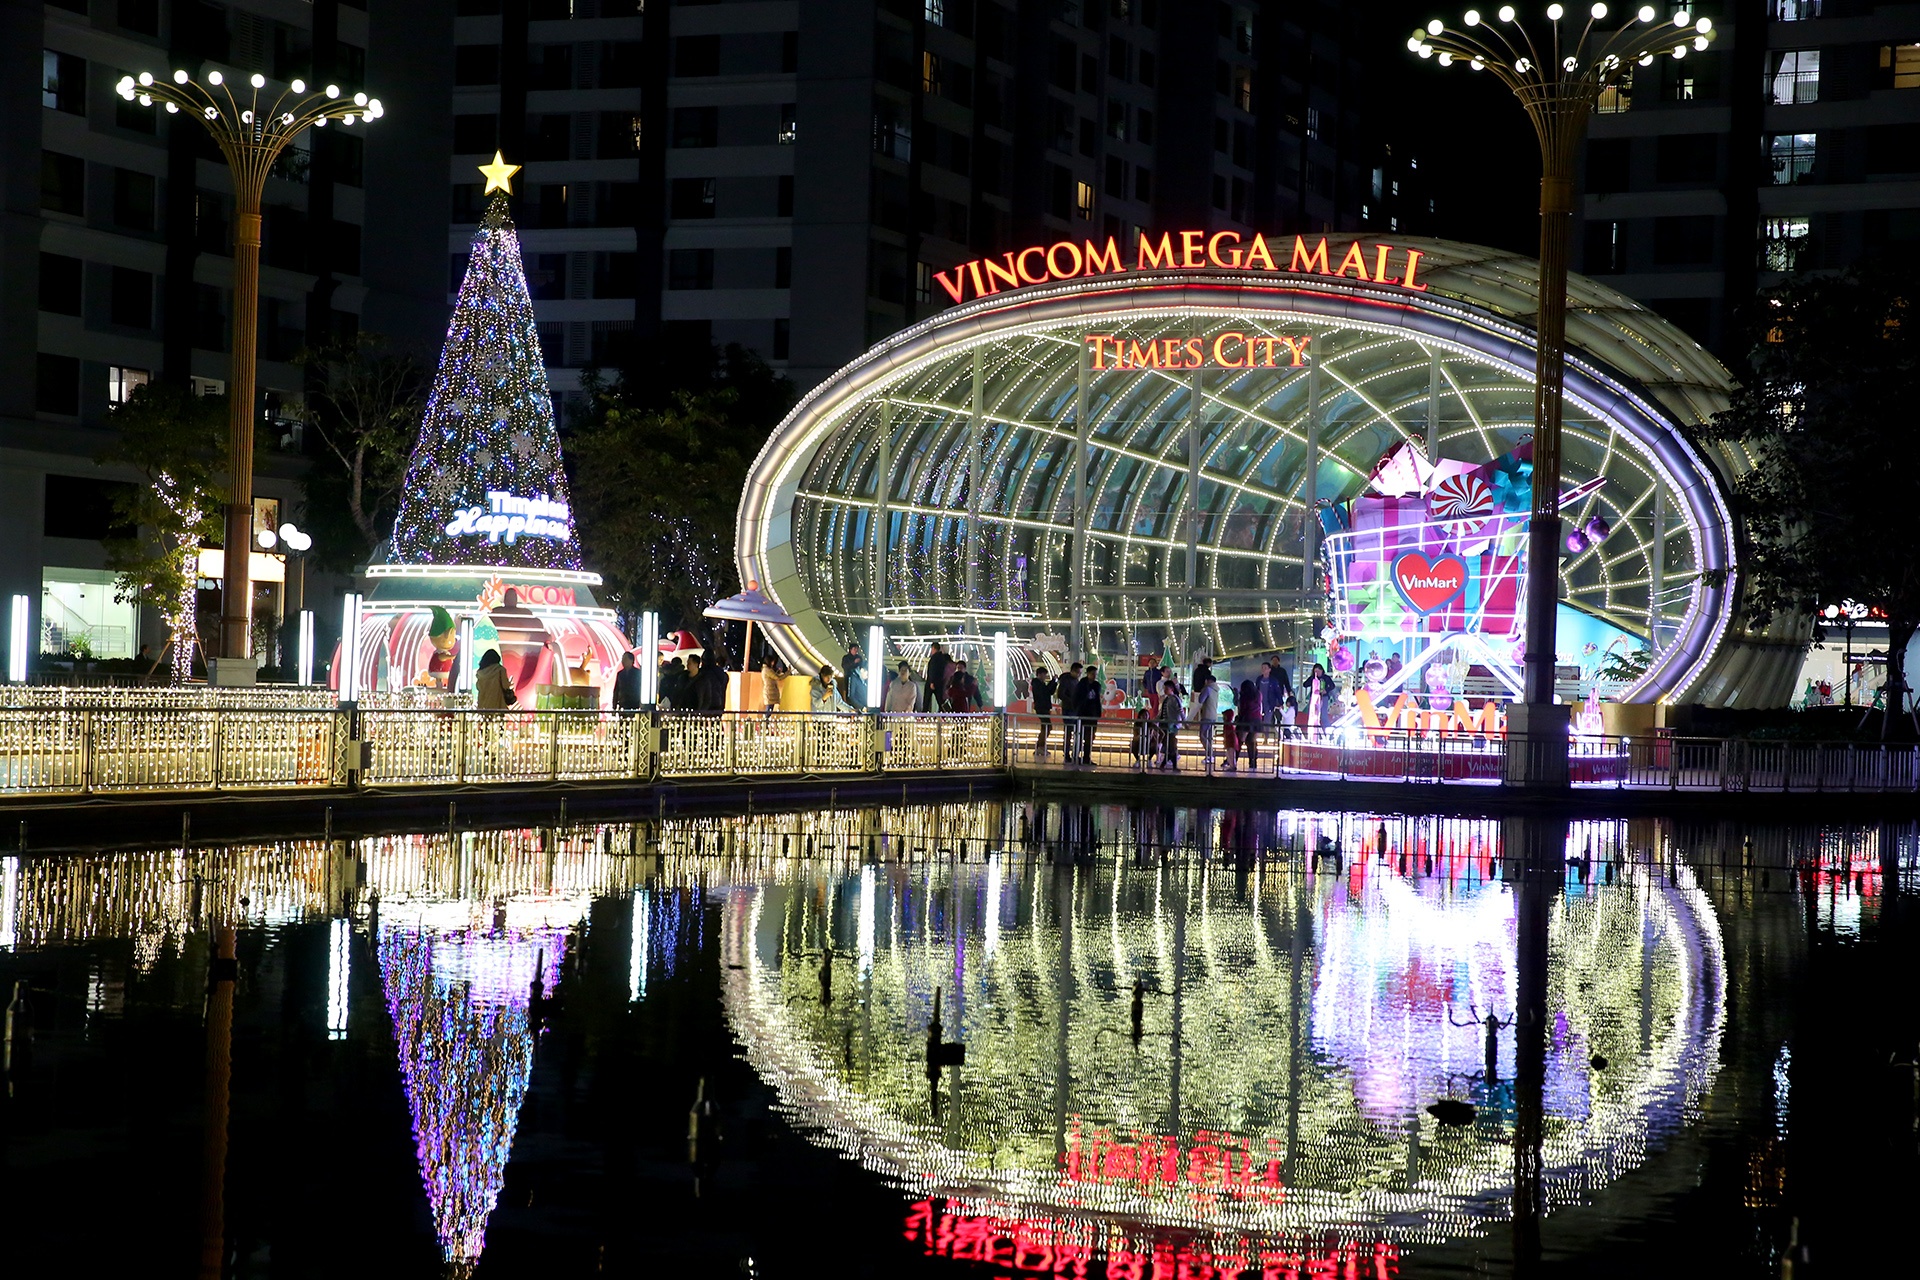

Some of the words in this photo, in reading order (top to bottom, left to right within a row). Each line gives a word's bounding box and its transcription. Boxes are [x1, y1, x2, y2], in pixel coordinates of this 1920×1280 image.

[933, 235, 1127, 304] VINCOM
[1136, 230, 1278, 271] MEGA
[1288, 235, 1427, 292] MALL
[1084, 333, 1203, 370] TIMES
[1213, 332, 1312, 368] CITY
[499, 583, 577, 606] INCOM
[1401, 574, 1458, 591] VinMart
